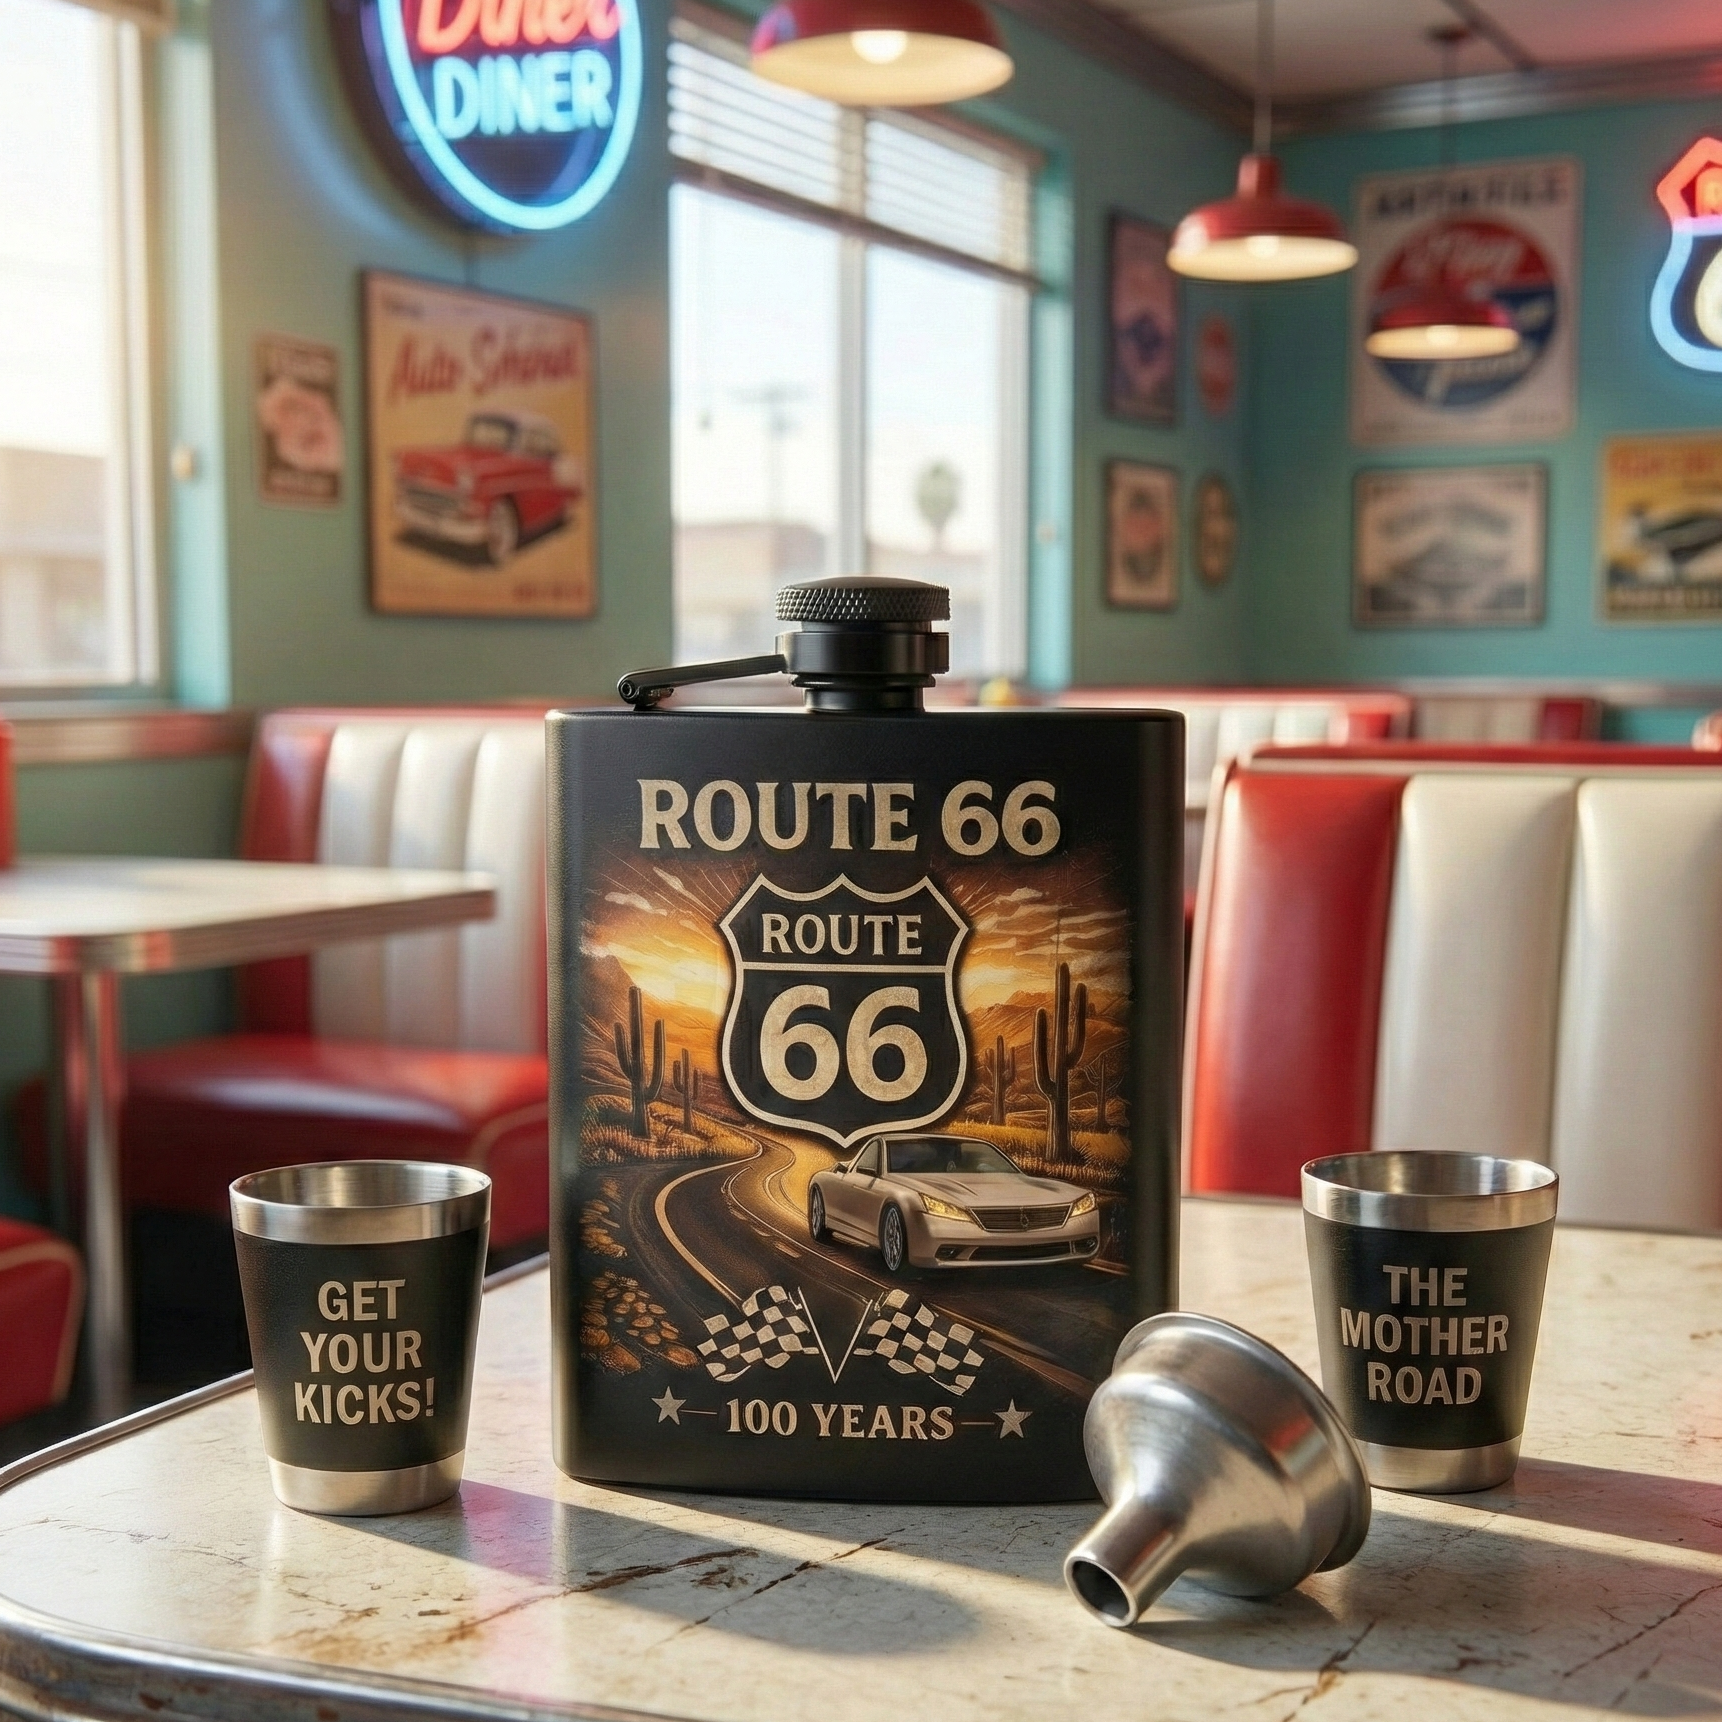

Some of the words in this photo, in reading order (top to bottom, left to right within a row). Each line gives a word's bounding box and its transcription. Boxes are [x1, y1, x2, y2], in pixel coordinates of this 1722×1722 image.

[433, 49, 613, 140] DINER
[637, 779, 917, 852] ROUTE
[941, 780, 1061, 856] 66
[761, 913, 923, 956] ROUTE
[760, 985, 928, 1102] 66
[317, 1279, 406, 1321] GET
[1382, 1264, 1468, 1307] THE
[300, 1330, 422, 1374] YOUR
[1340, 1307, 1509, 1356] MOTHER
[294, 1377, 435, 1425] KICKS!
[1367, 1361, 1482, 1405] ROAD
[726, 1398, 798, 1436] 100
[811, 1403, 954, 1440] YEARS
